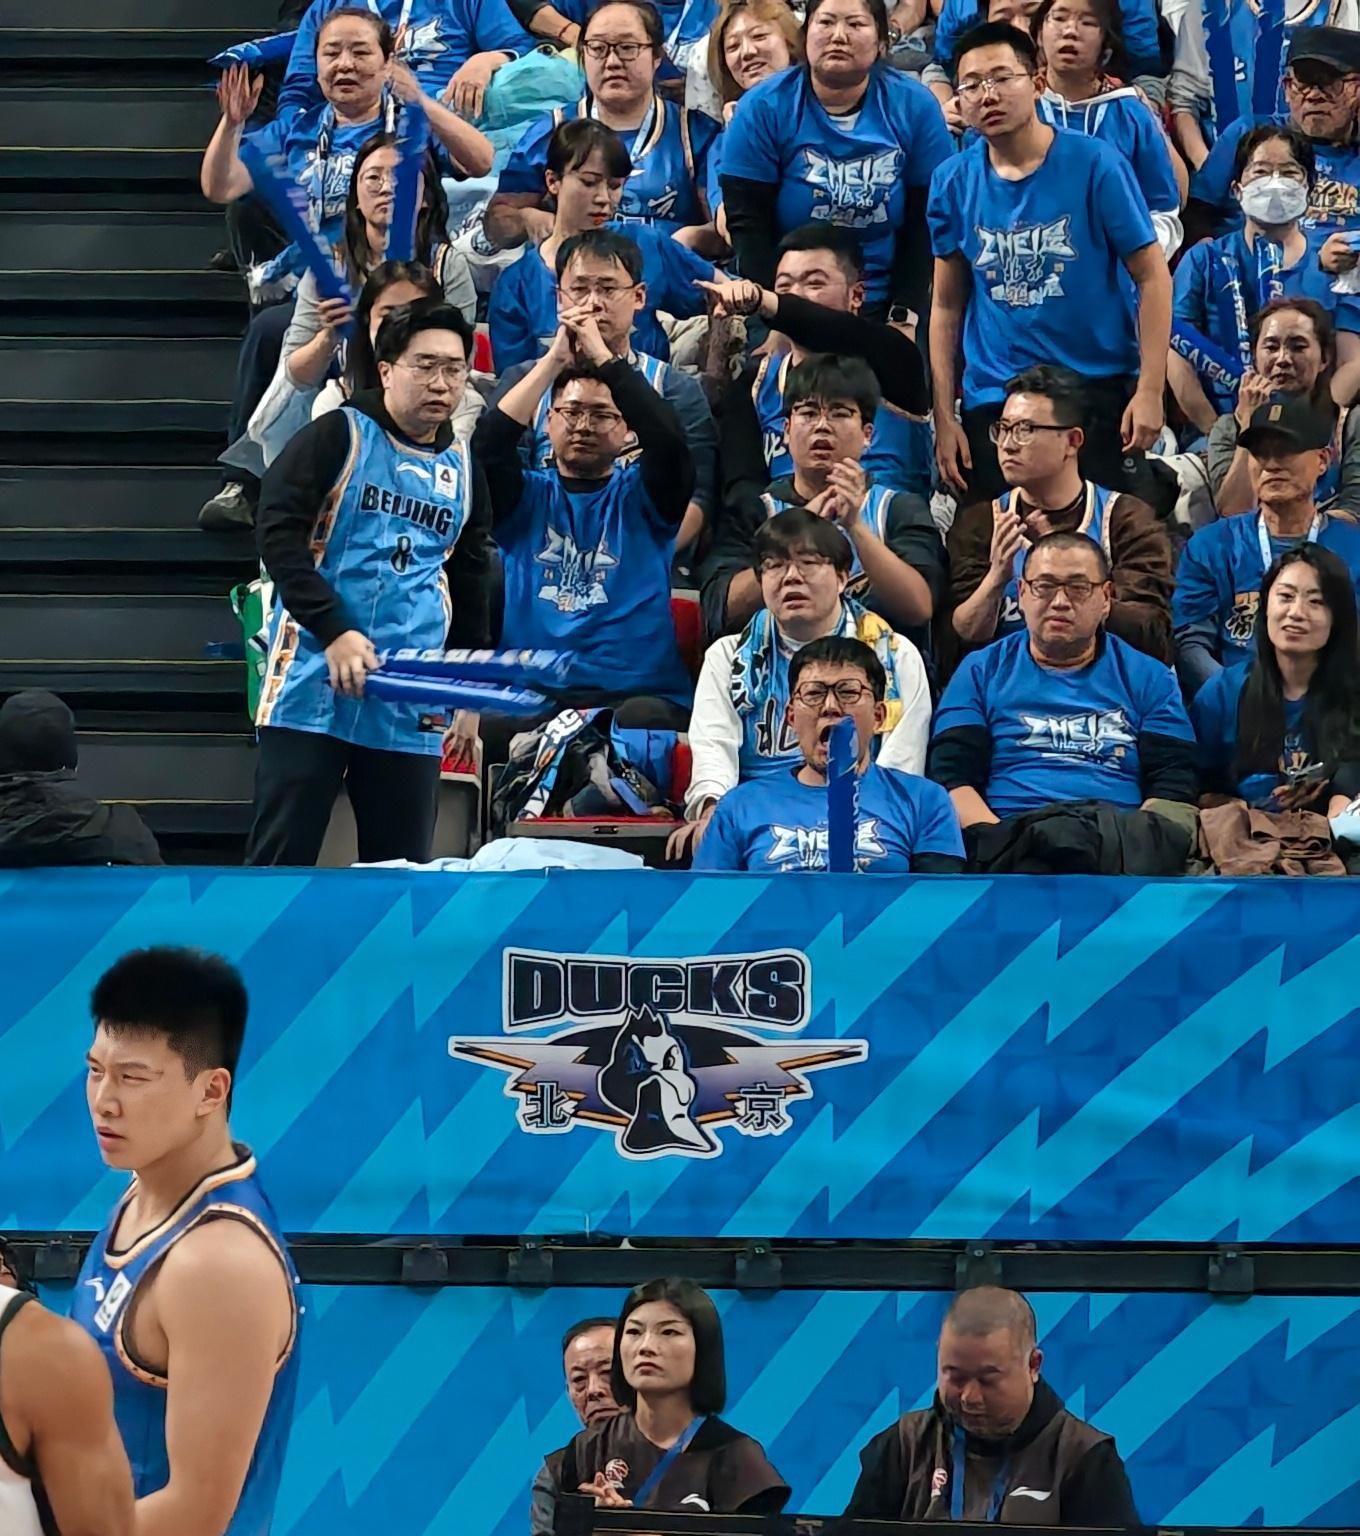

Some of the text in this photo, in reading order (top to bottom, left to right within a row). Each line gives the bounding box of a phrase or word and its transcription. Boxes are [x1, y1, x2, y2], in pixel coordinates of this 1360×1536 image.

[360, 482, 454, 537] BEIJING
[390, 535, 411, 575] 8
[510, 954, 805, 1020] DUCKS
[526, 1081, 787, 1130] 北 京
